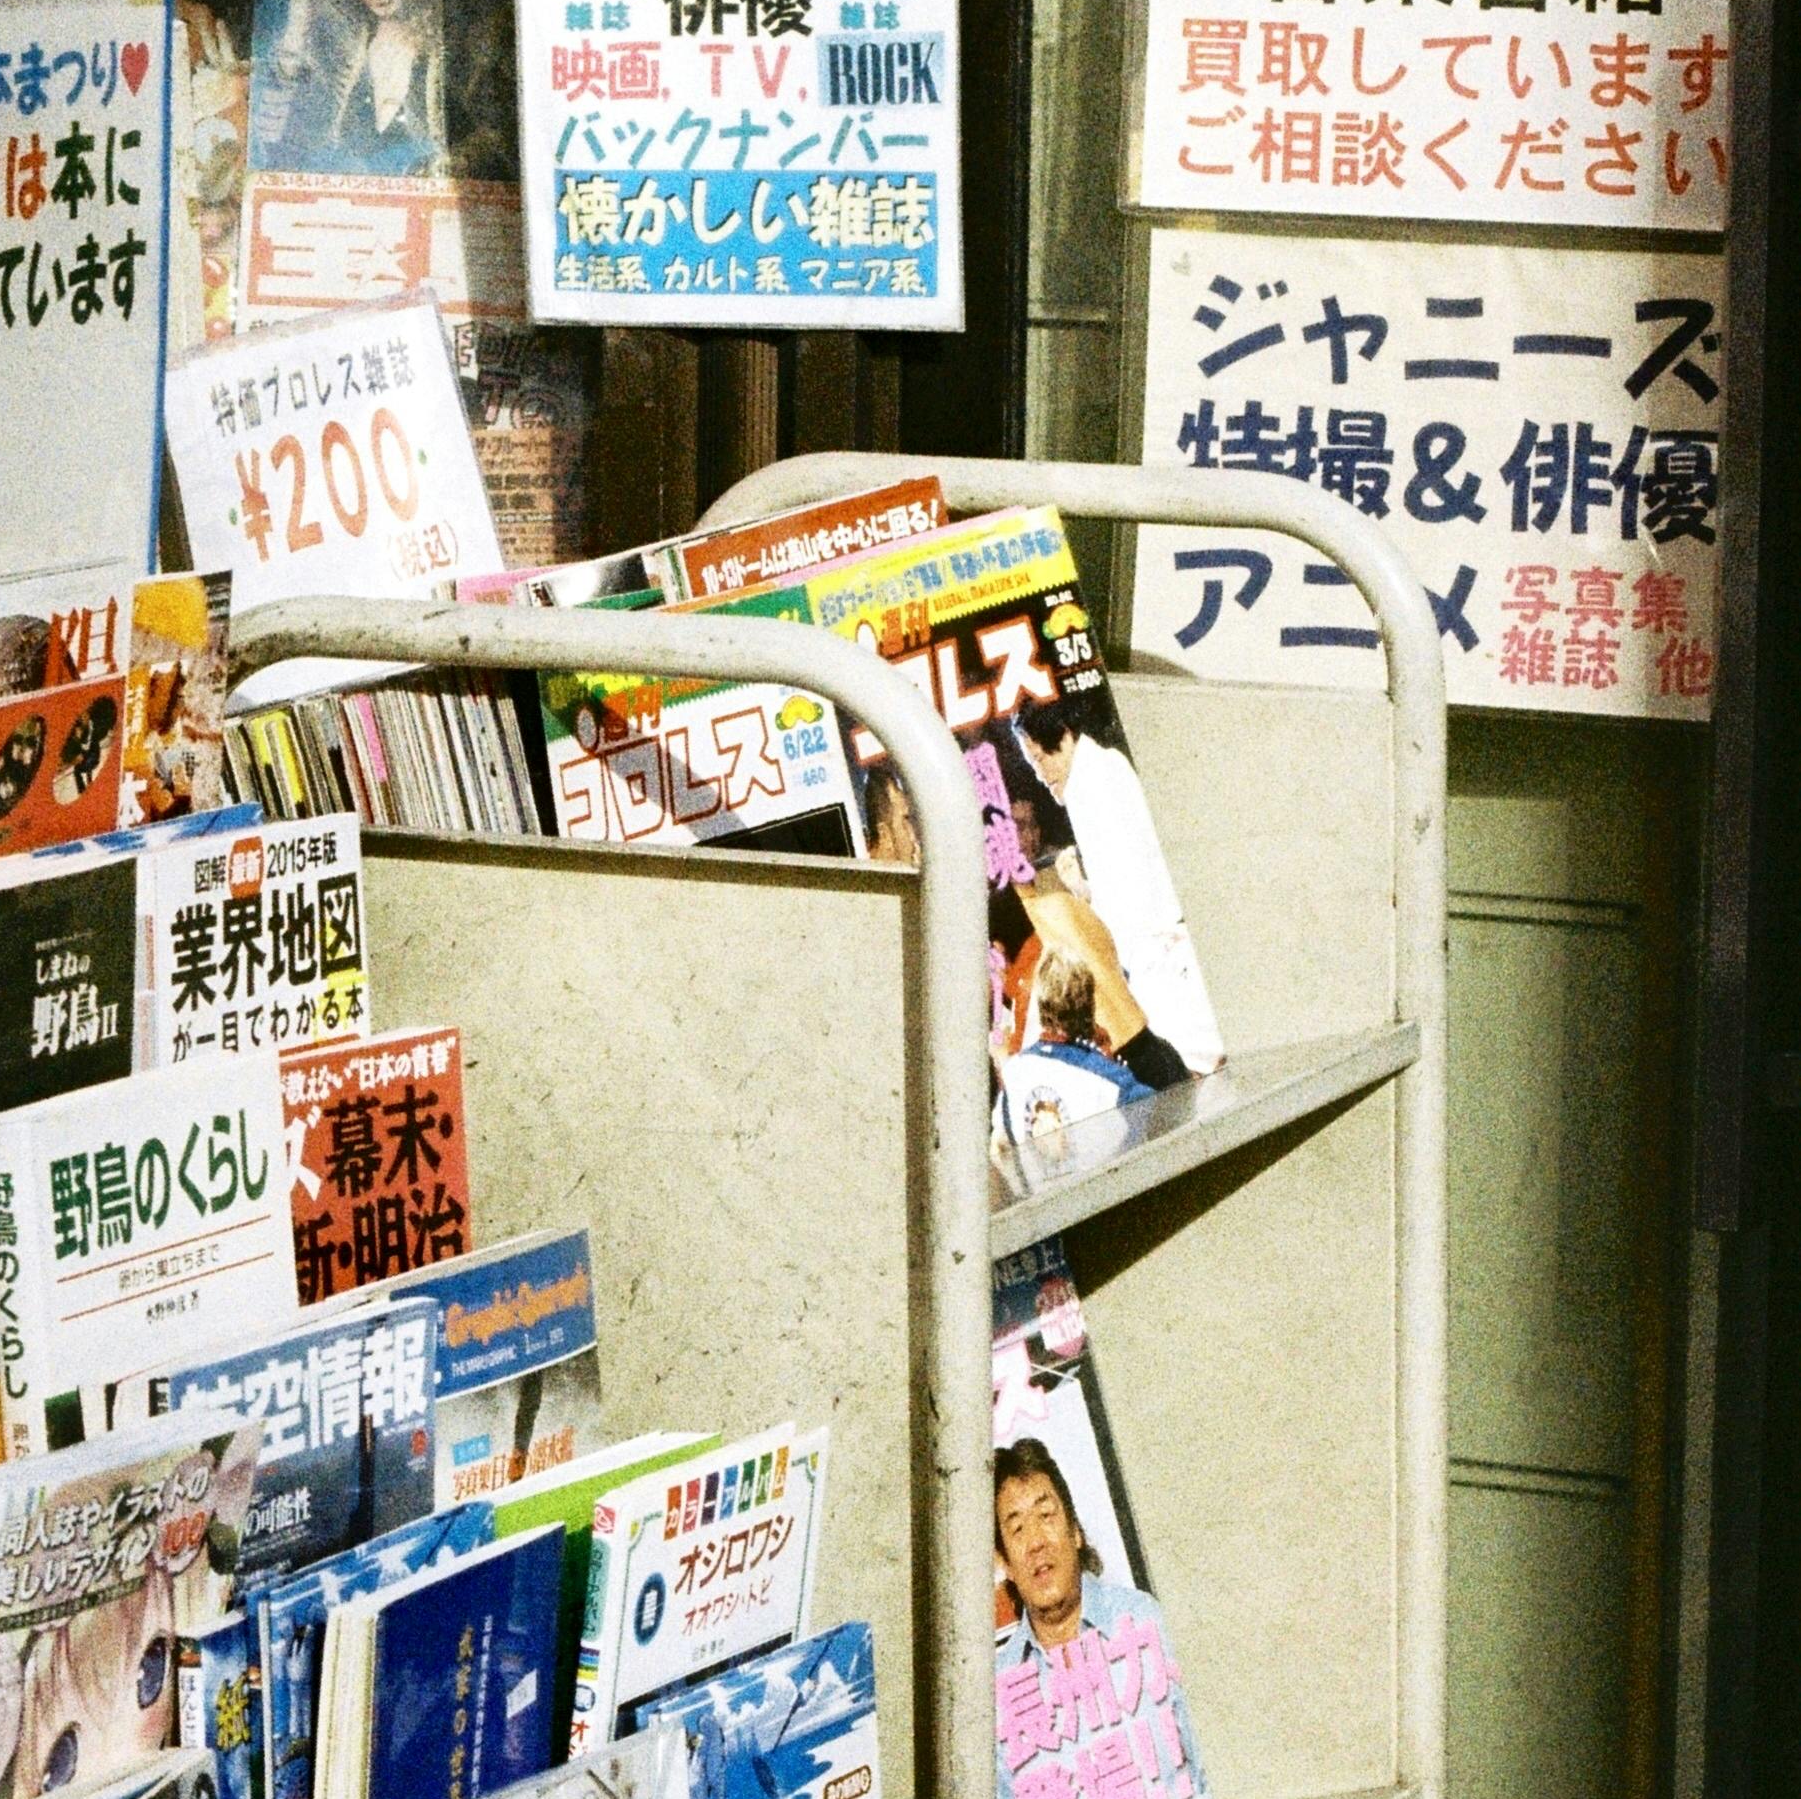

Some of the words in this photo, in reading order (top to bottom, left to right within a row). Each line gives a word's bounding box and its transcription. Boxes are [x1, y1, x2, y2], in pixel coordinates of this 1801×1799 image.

[564, 0, 631, 33] 雑誌
[838, 1, 902, 33] 雑誌
[826, 31, 939, 105] ROCK
[1178, 16, 1730, 115] 買取しています
[553, 107, 930, 171] バックナンバー
[1178, 104, 1730, 197] ご相談ください
[557, 173, 936, 249] 懐かしい雑誌
[1192, 273, 1722, 405] ジャニーズ
[210, 337, 415, 438] 特価プロレス雑誌
[234, 407, 420, 563] ¥200
[1501, 564, 1689, 635] 写真集
[1054, 632, 1093, 668] 3/3
[1498, 625, 1621, 691] 雑誌
[1654, 635, 1715, 698] 他
[560, 706, 785, 841] プロレス
[783, 725, 829, 765] 6/22
[194, 852, 228, 895] 図解
[230, 841, 263, 885] 最新
[265, 830, 339, 880] 2015年版
[170, 872, 363, 1013] 業界地図
[171, 981, 365, 1063] が一目でわかる本
[49, 1107, 269, 1262] 野鳥のくらし
[116, 1241, 222, 1290] 卵から巣立ちまで
[663, 1445, 789, 1543] カラーアルバム
[674, 1514, 795, 1597] オジロワシ
